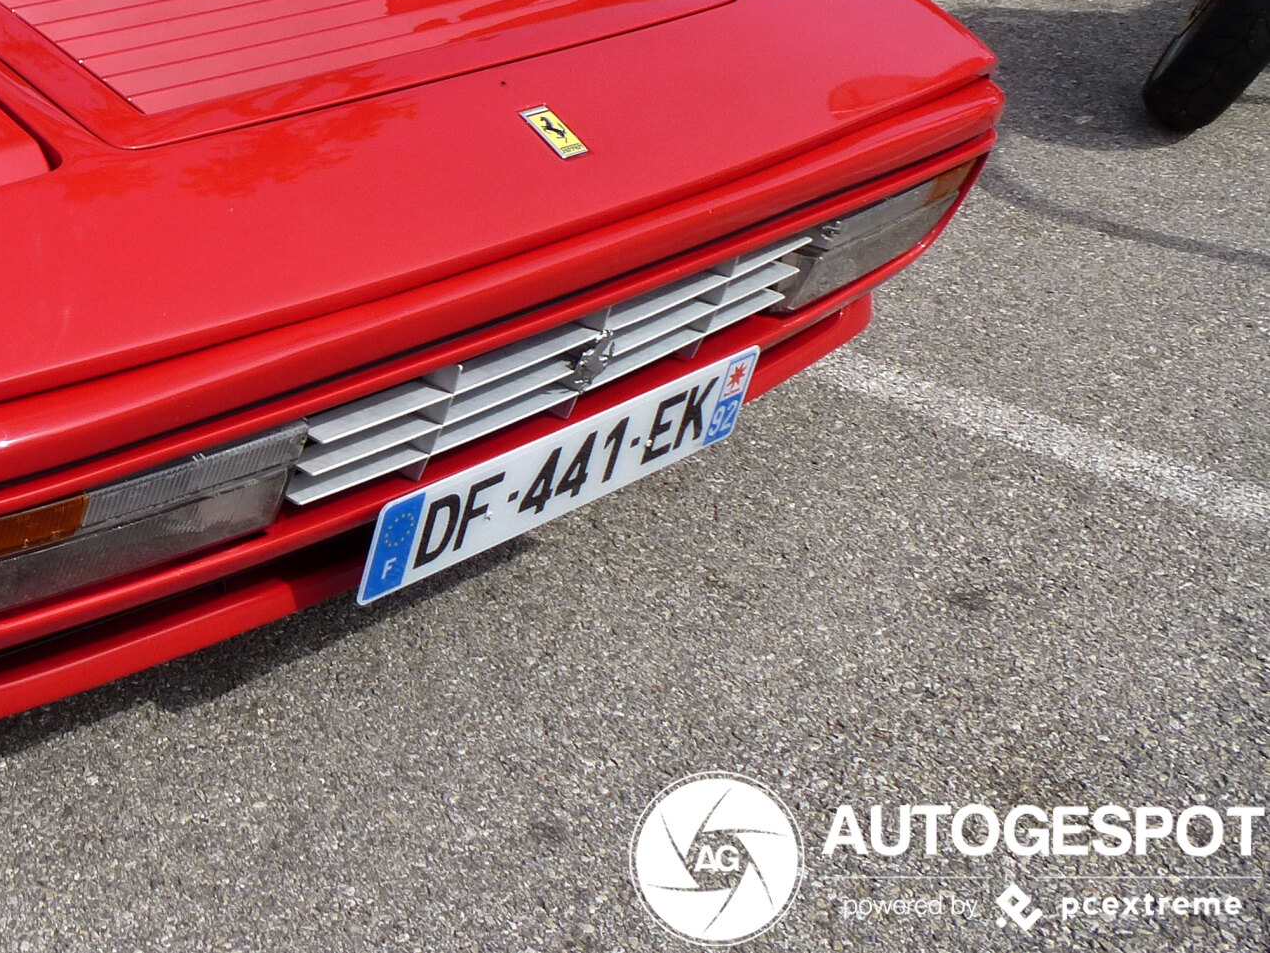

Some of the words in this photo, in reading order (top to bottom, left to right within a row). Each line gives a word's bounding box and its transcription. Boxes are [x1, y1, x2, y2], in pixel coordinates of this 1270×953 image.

[709, 399, 739, 437] 92
[413, 376, 720, 569] DF-441-EK
[381, 557, 397, 580] F
